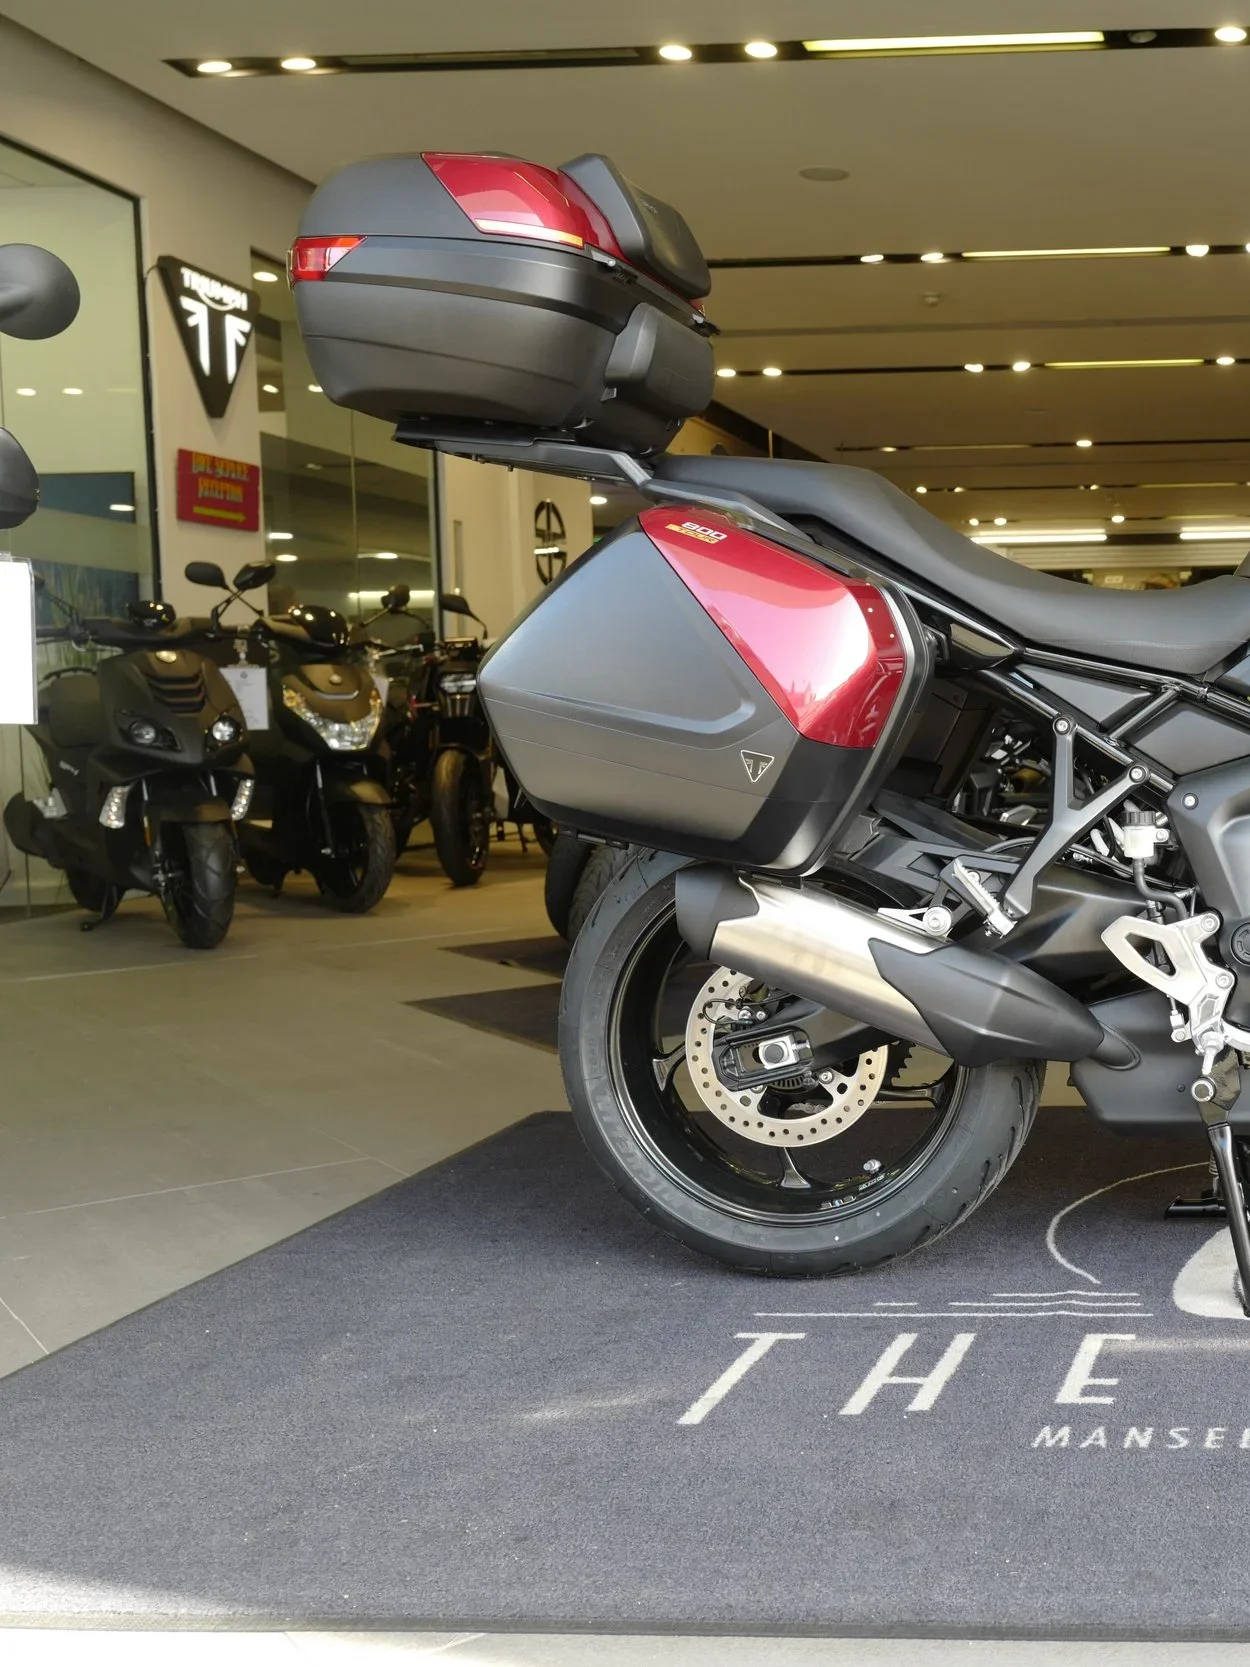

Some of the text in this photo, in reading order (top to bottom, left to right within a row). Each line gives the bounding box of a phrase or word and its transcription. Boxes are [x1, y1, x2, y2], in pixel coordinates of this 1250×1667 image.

[180, 266, 248, 311] TRIUMPH
[681, 521, 728, 541] 800
[676, 1331, 1170, 1425] THE
